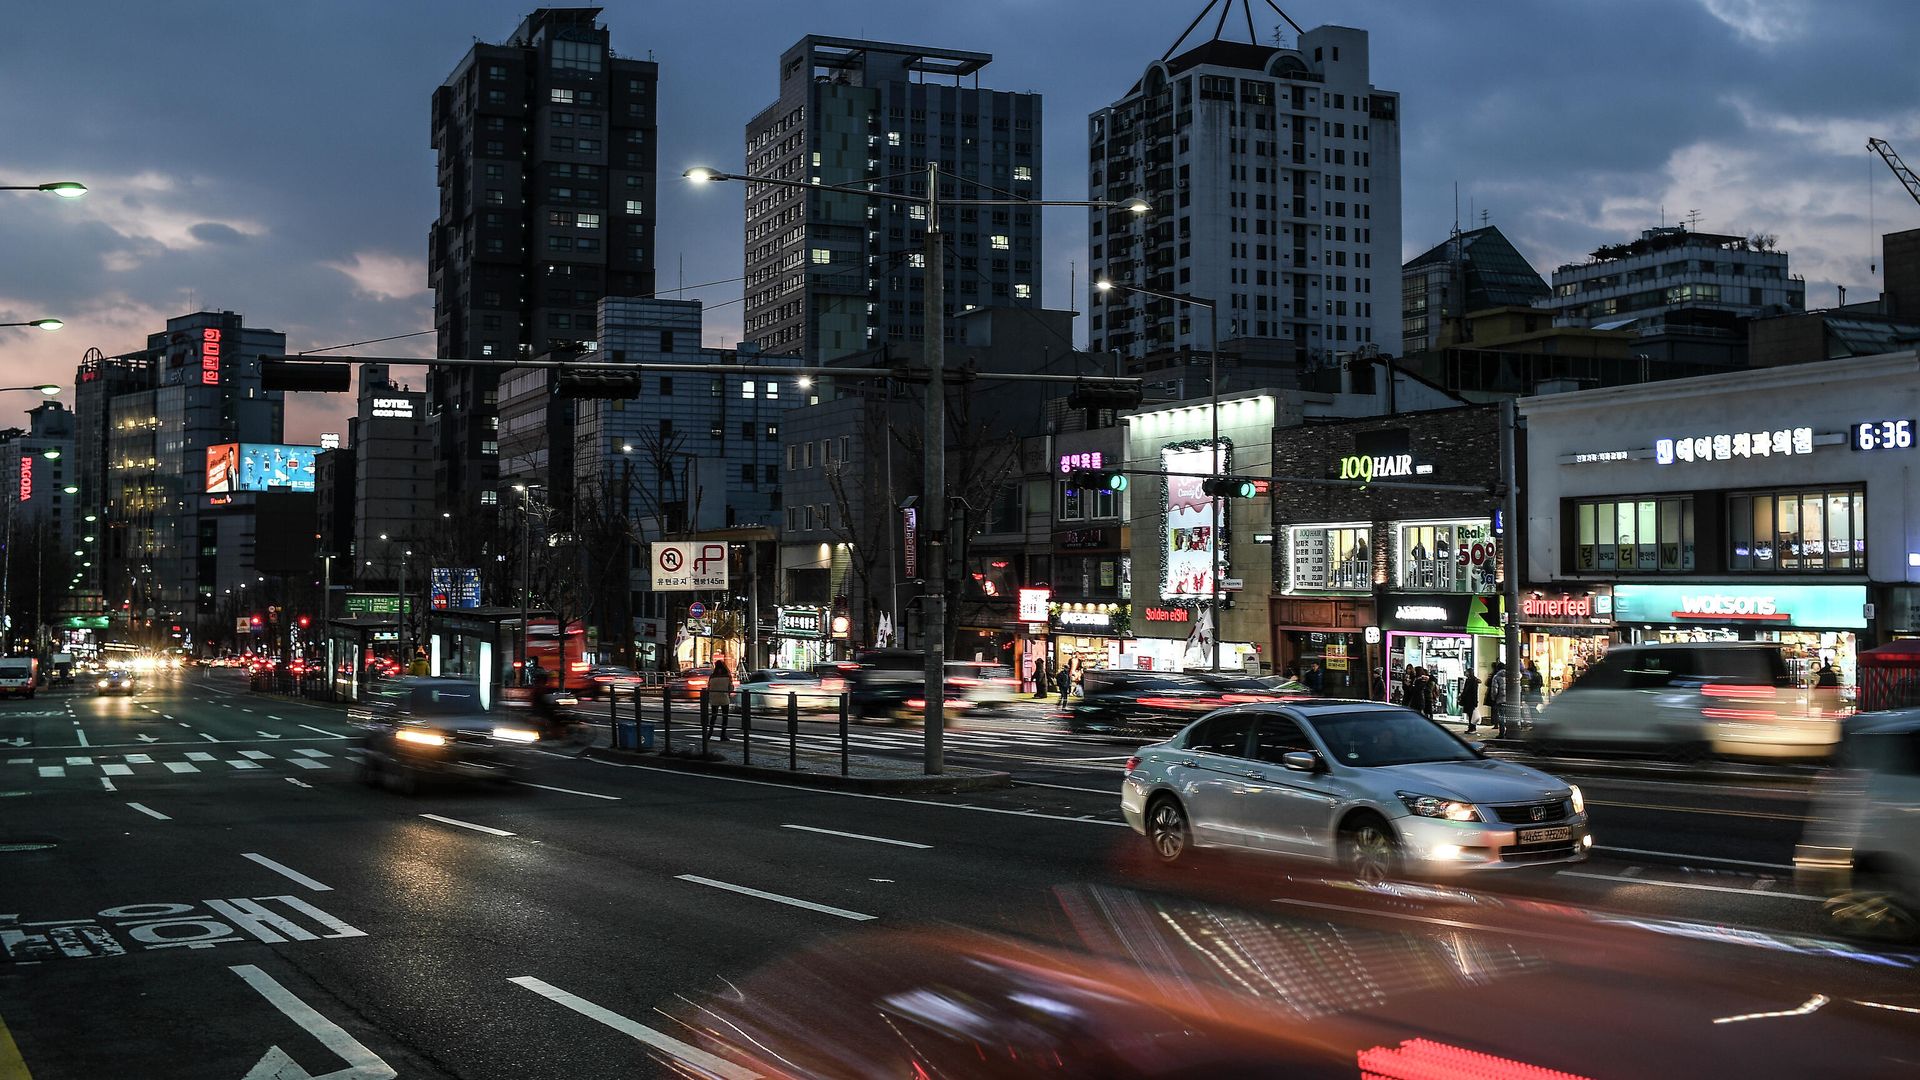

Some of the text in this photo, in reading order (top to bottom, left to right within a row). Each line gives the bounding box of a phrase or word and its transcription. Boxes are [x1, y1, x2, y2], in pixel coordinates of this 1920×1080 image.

[373, 398, 414, 410] HOTEL
[1859, 420, 1910, 450] 6:36
[1060, 452, 1101, 473] 성인용품
[1339, 454, 1412, 482] 109HAIR
[20, 456, 32, 502] PAGODA
[1457, 525, 1480, 539] Real
[1621, 547, 1633, 566] 더
[1663, 547, 1678, 565] NO
[1523, 596, 1590, 616] aimerfeel
[1682, 594, 1777, 615] watsons
